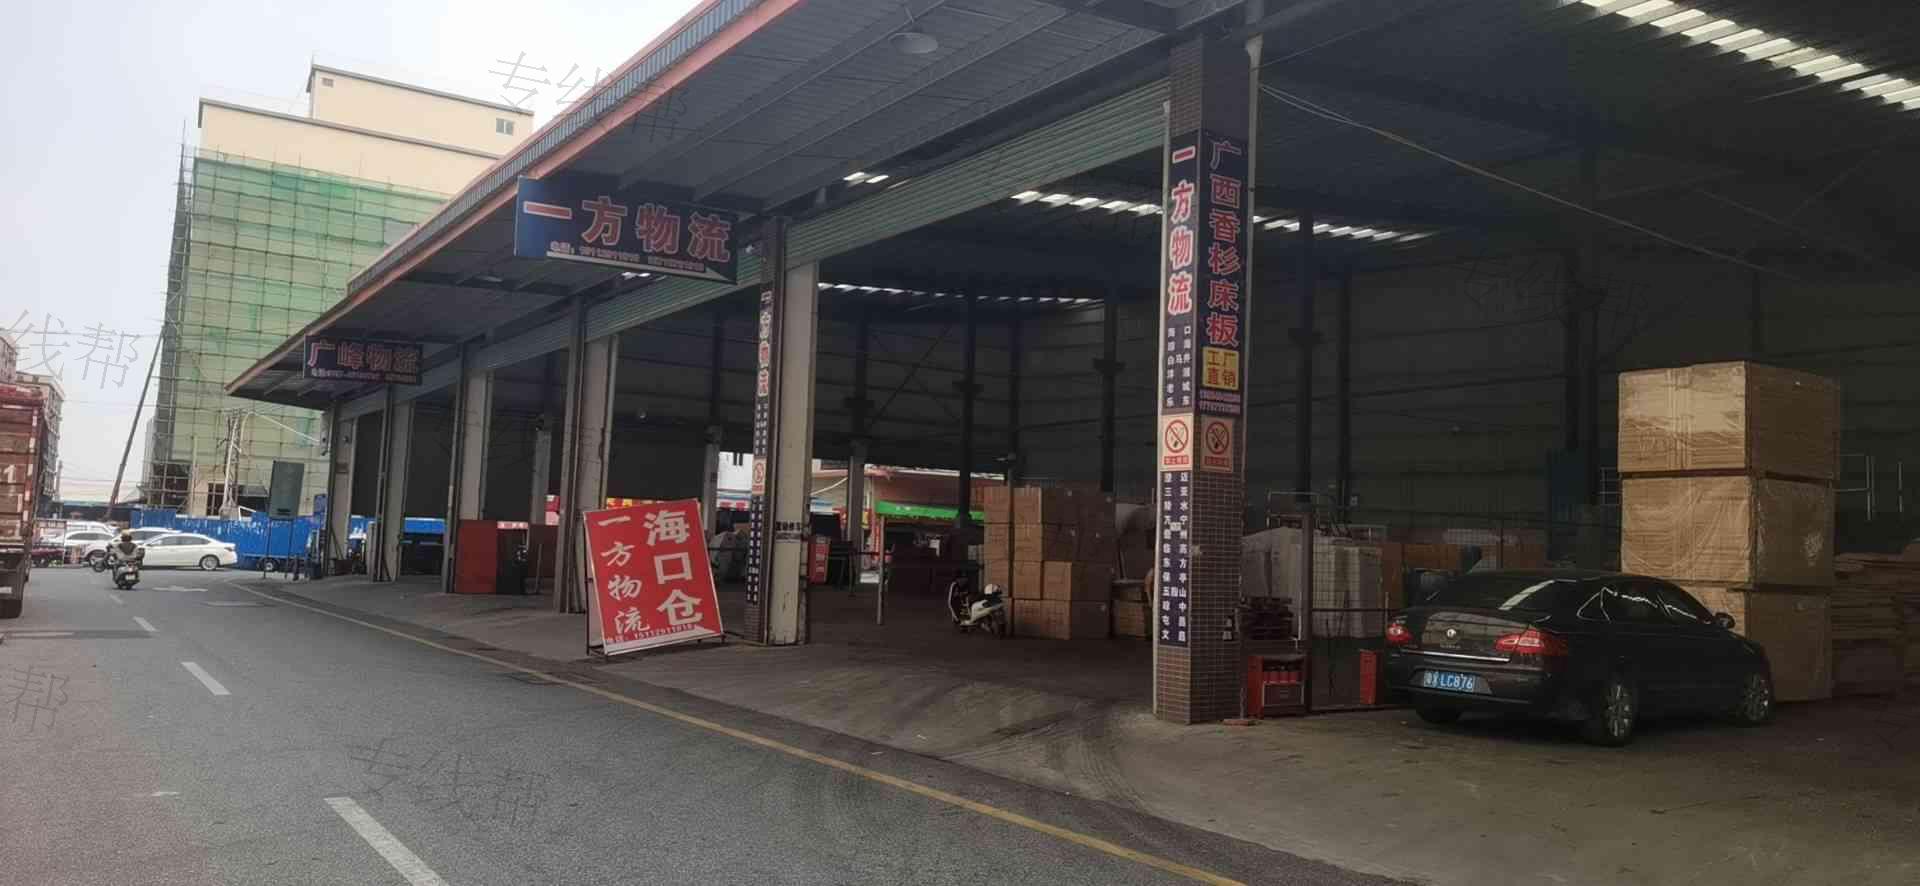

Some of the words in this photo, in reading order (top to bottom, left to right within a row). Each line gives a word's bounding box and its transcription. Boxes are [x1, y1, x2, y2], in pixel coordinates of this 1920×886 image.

[523, 196, 731, 262] 一方物流
[1168, 145, 1196, 315] 一方物流
[1207, 140, 1242, 347] 广西香杉床板
[598, 514, 650, 634] 一方物流
[643, 510, 704, 626] 海口仓
